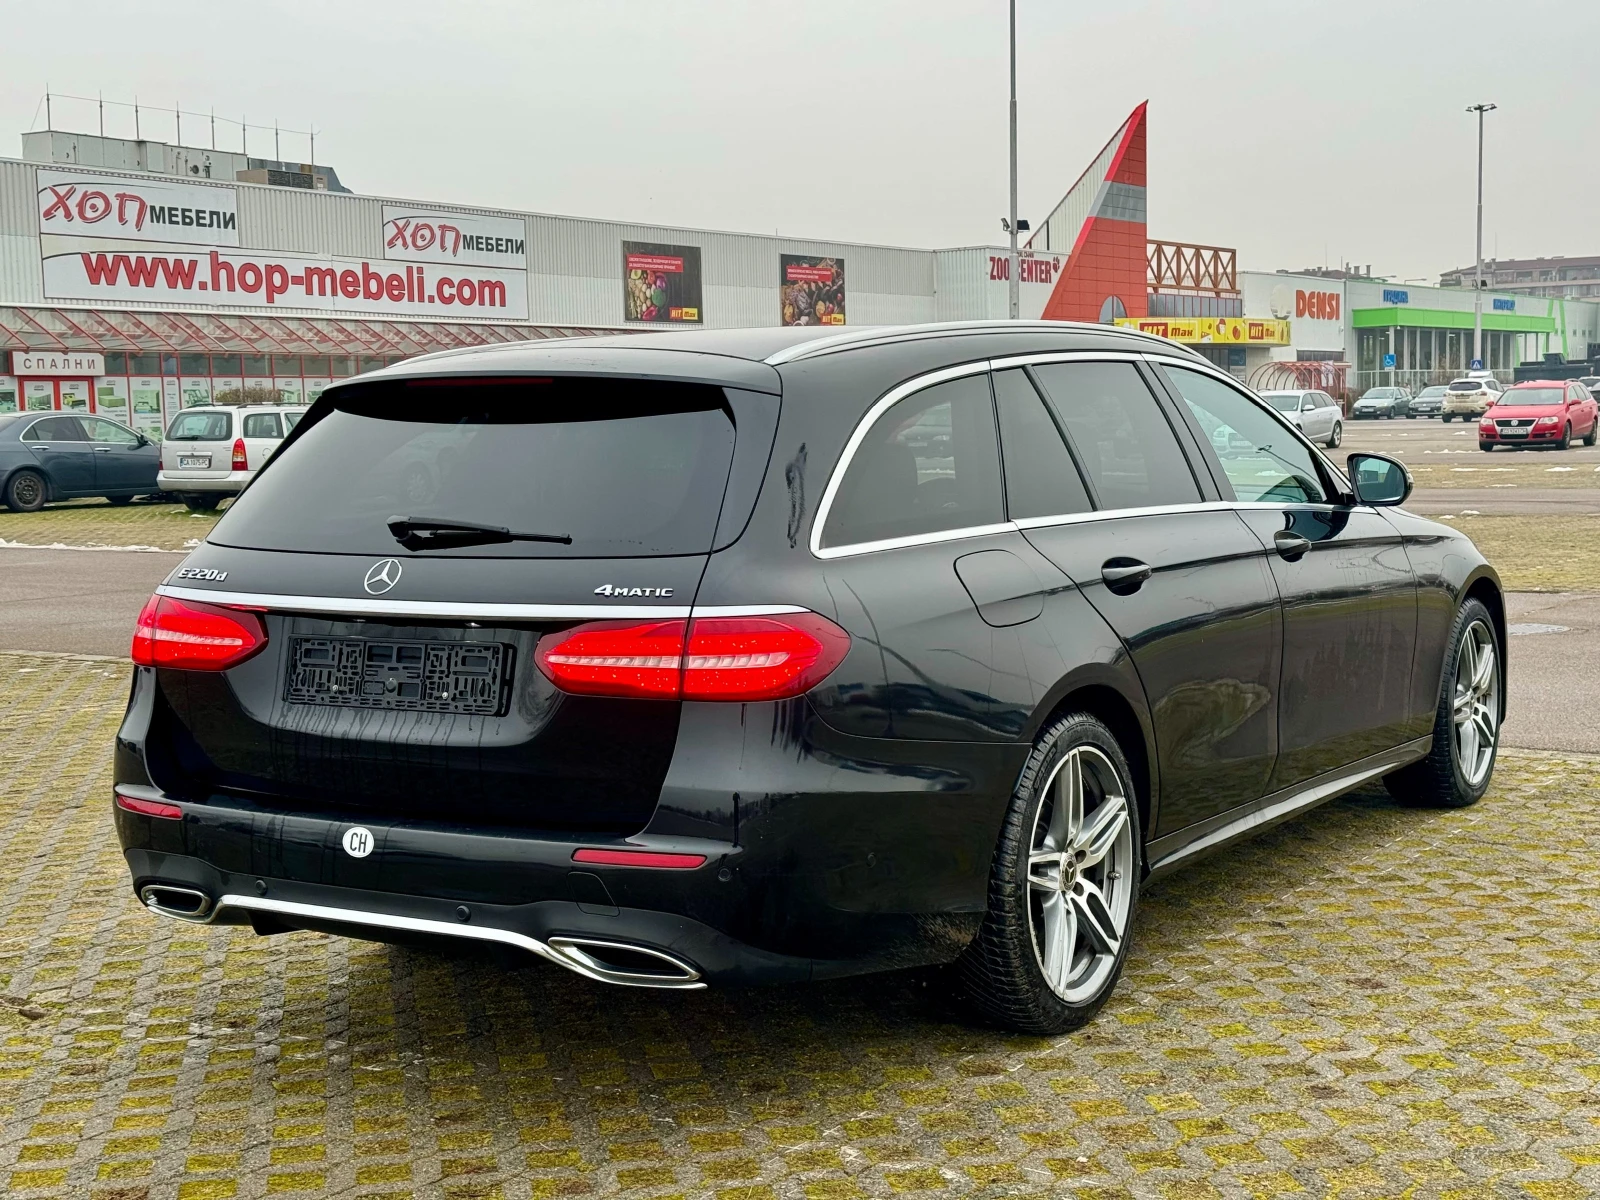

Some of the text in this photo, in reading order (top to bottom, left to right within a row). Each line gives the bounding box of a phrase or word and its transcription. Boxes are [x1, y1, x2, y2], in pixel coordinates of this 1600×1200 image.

[42, 185, 236, 232] ХОП МЕБЕЛИ
[387, 219, 525, 257] ХОП МЕБЕЛИ
[81, 251, 506, 307] www.hop-mebeli.com
[989, 256, 1010, 281] ZOO
[1296, 289, 1340, 320] DENSI
[1171, 327, 1193, 337] Max
[1250, 326, 1263, 337] HIT
[23, 358, 96, 369] СПАЛНИ
[178, 567, 229, 582] E220d
[593, 584, 674, 598] 4MATIC
[350, 832, 367, 853] CH
